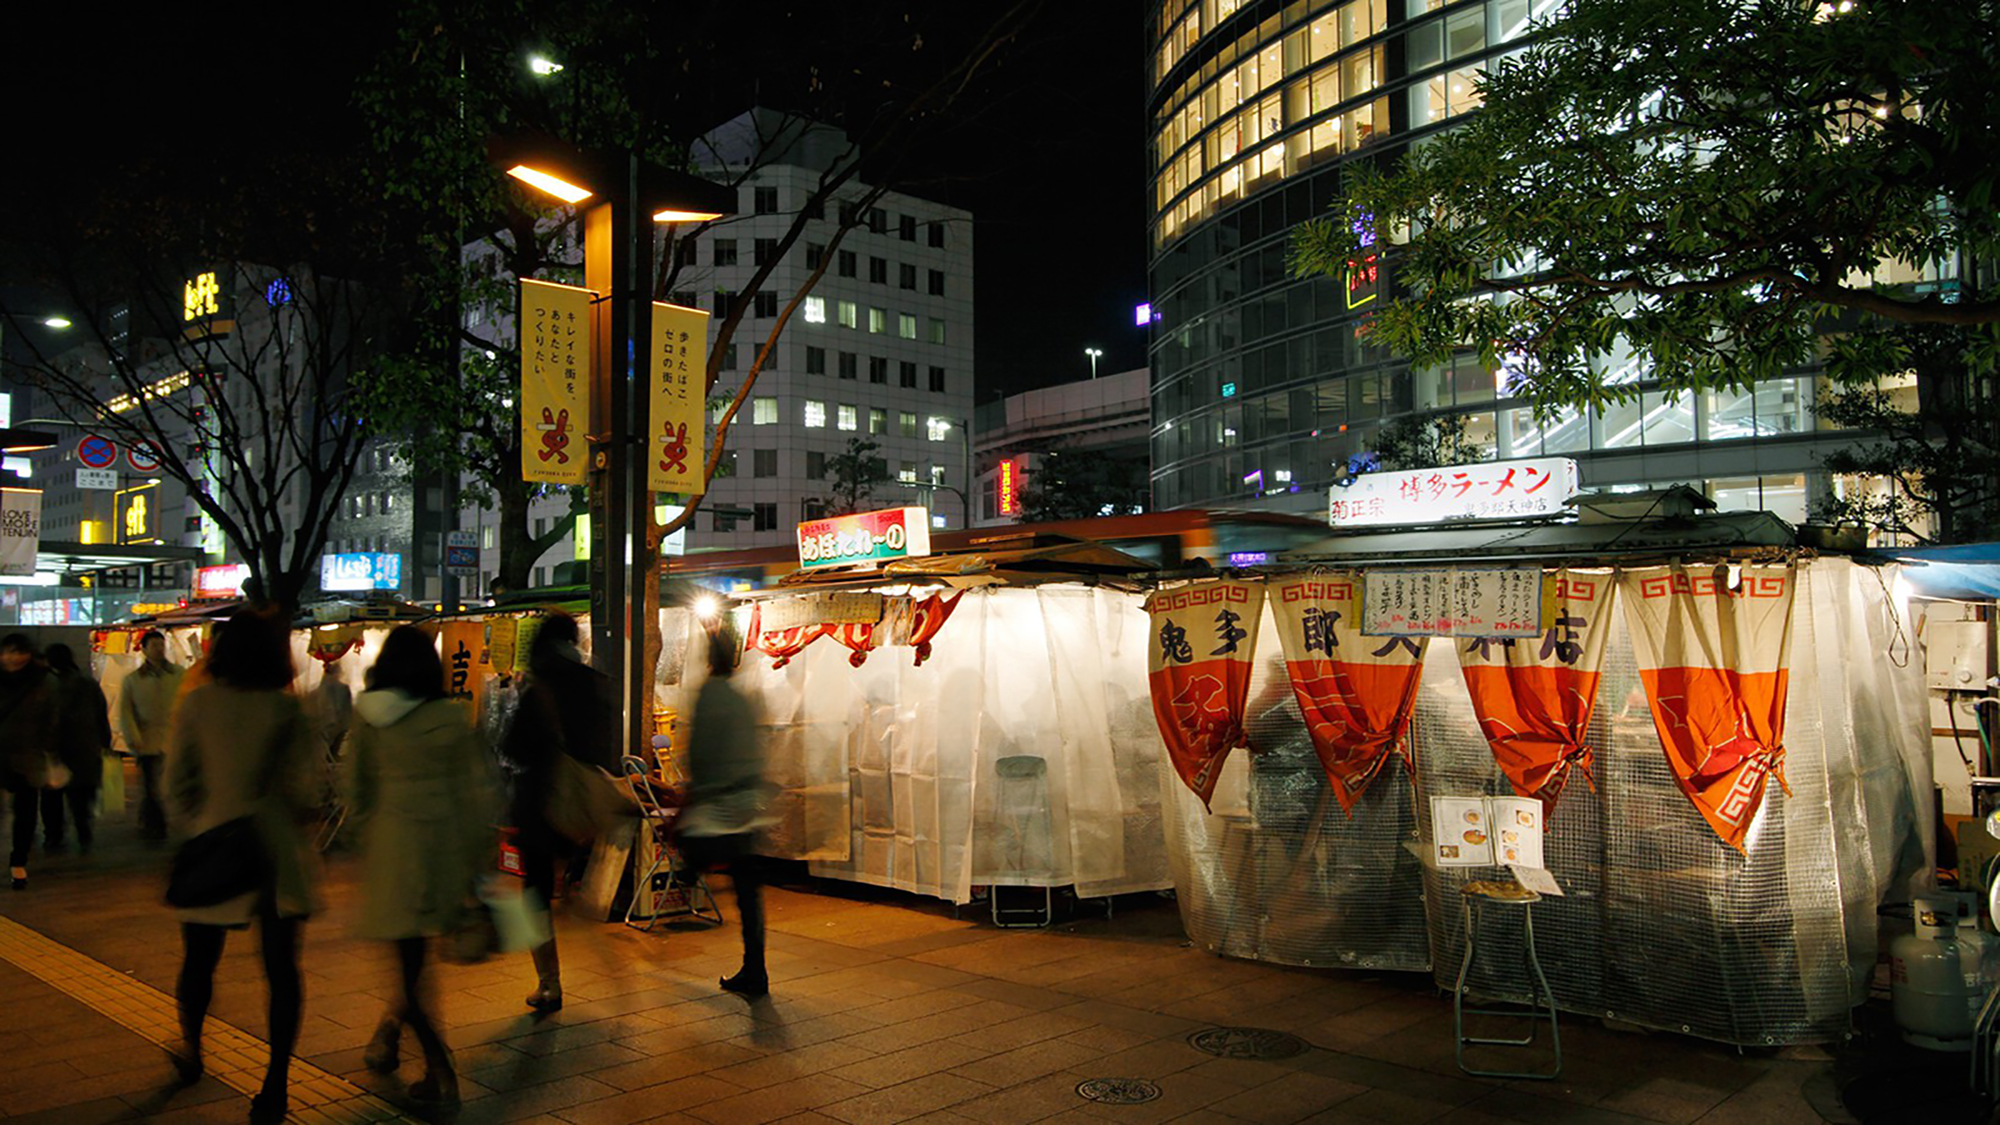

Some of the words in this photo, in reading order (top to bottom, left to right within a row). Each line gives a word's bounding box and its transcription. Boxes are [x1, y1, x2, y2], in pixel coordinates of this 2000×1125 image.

[550, 310, 561, 364] あなたと
[564, 311, 577, 401] キレイな街を、
[1400, 467, 1551, 502] 博多ラーメン
[3, 509, 31, 519] LOVE
[1331, 497, 1386, 520] 菊正宗
[2, 518, 38, 530] MORE
[2, 527, 38, 538] TENJIN
